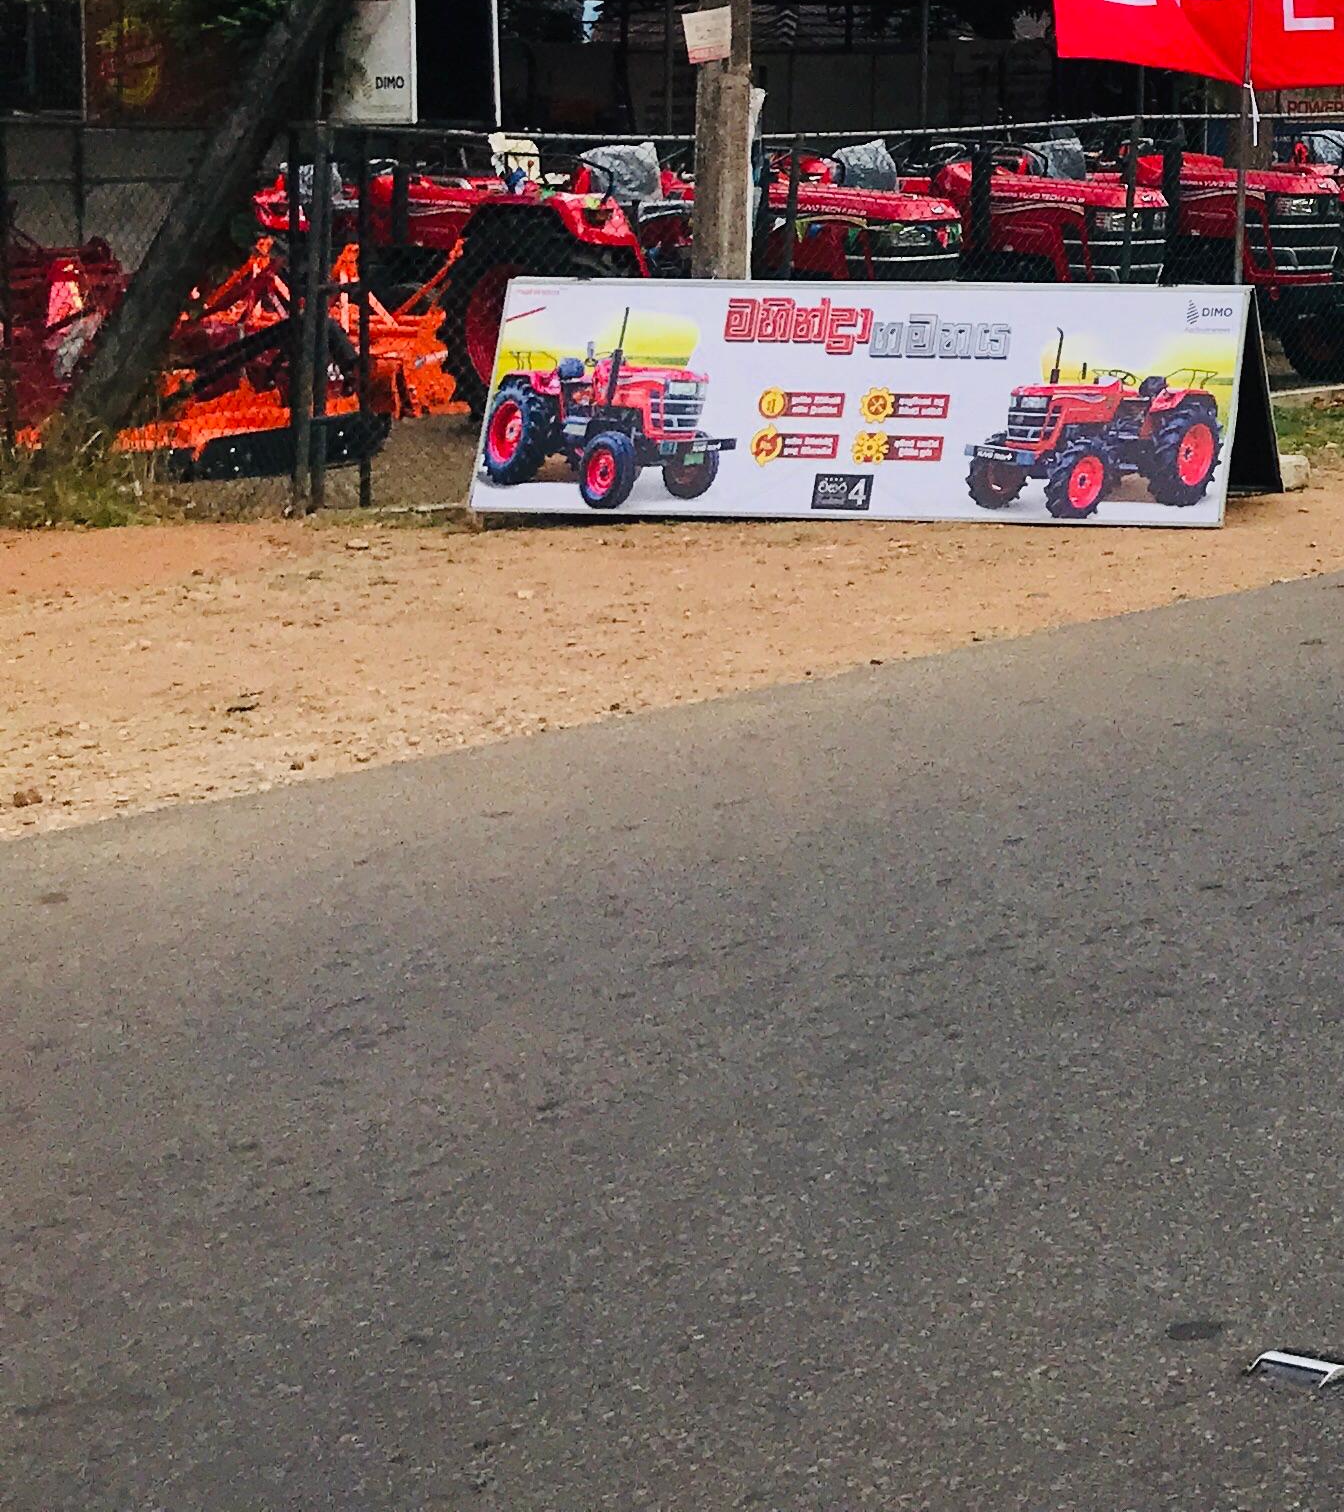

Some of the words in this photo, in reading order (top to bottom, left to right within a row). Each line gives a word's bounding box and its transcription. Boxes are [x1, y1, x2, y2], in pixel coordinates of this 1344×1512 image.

[375, 76, 405, 90] DIMO
[1201, 307, 1233, 317] DIMO
[848, 478, 867, 506] 4
